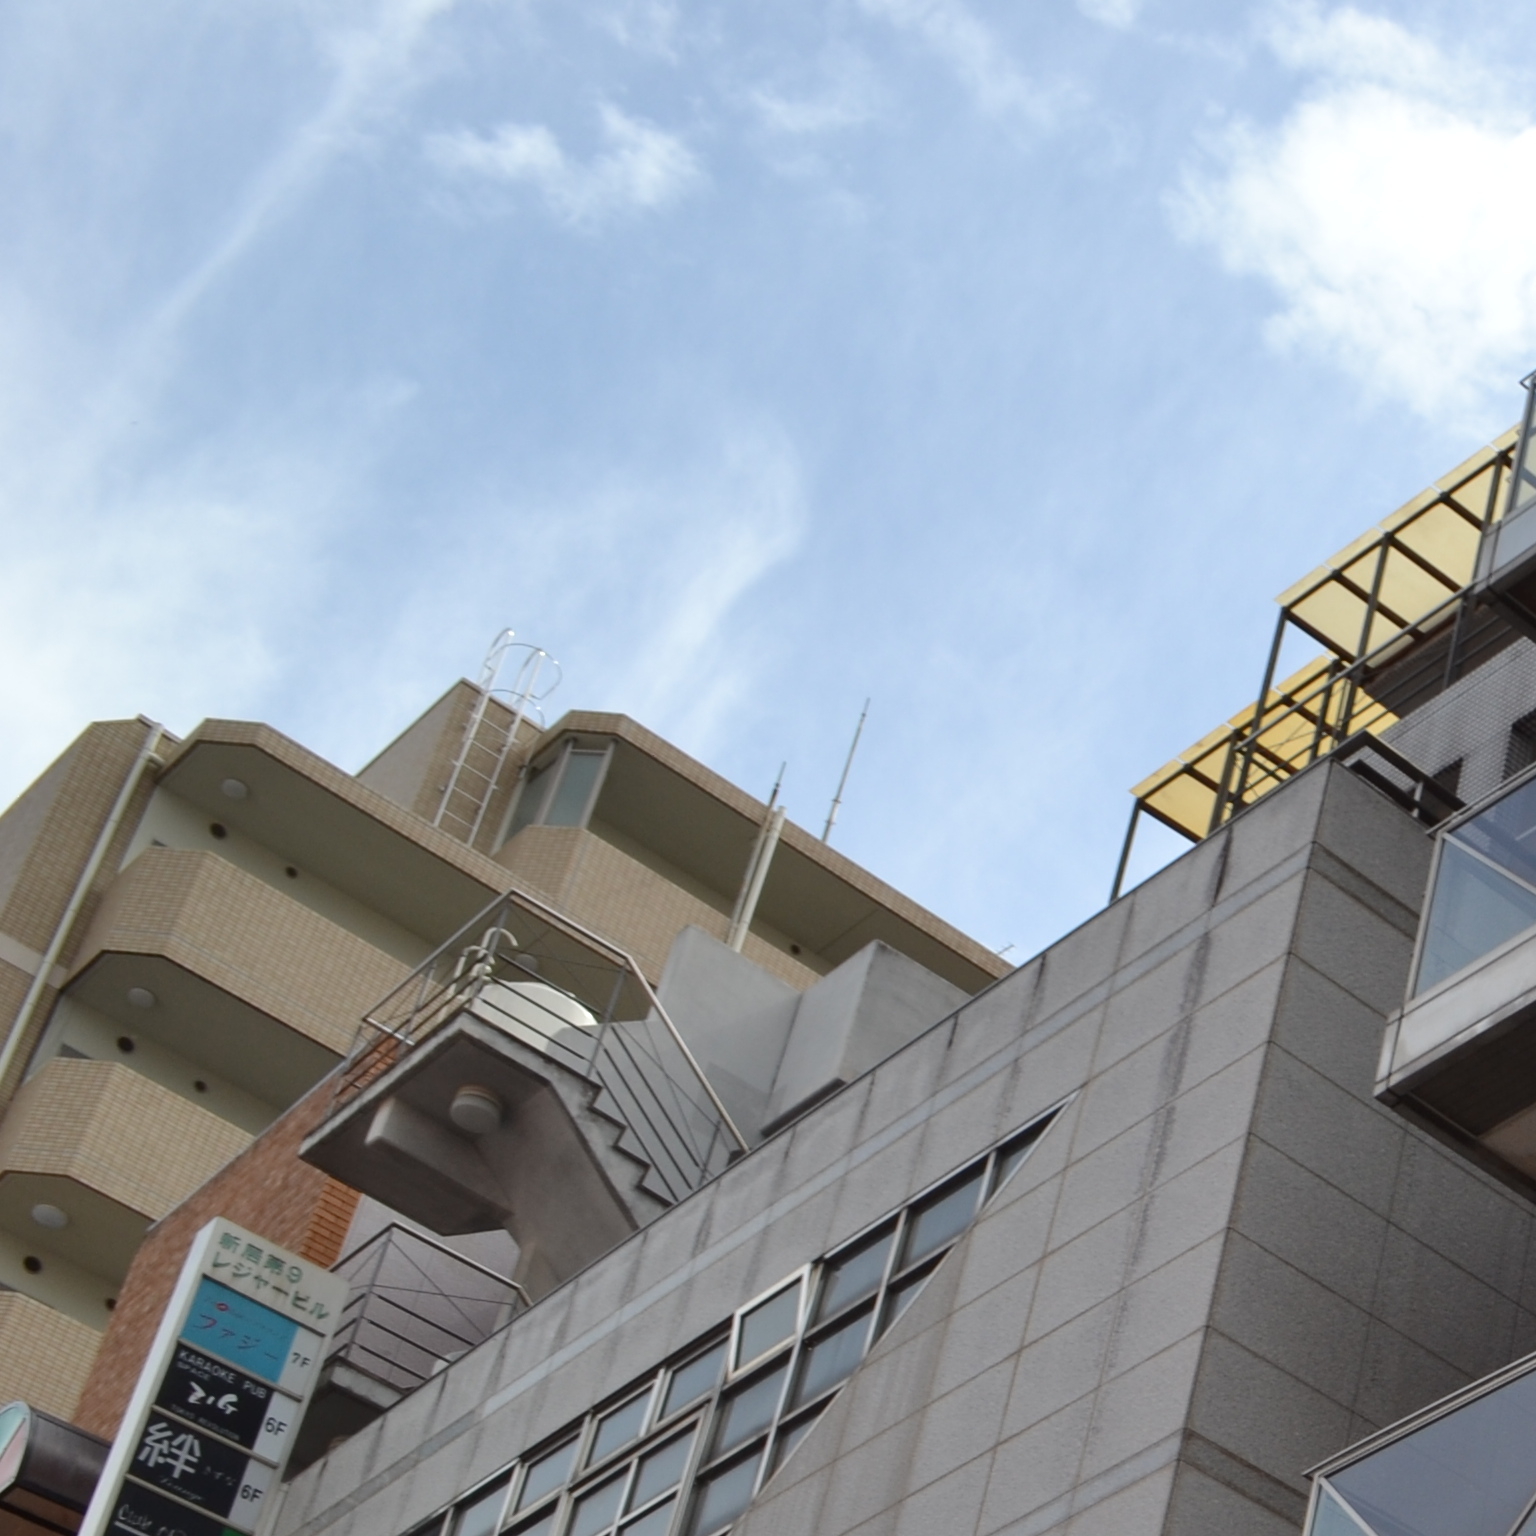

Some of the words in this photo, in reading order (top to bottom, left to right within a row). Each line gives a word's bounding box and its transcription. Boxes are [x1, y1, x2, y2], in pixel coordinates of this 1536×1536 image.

[212, 1252, 330, 1319] レジャービル
[178, 1351, 237, 1384] KARAOKE
[243, 1381, 267, 1398] PUB
[292, 1352, 311, 1367] 7F
[265, 1417, 287, 1436] 6F
[138, 1422, 201, 1479] 絆
[241, 1484, 263, 1503] 6F
